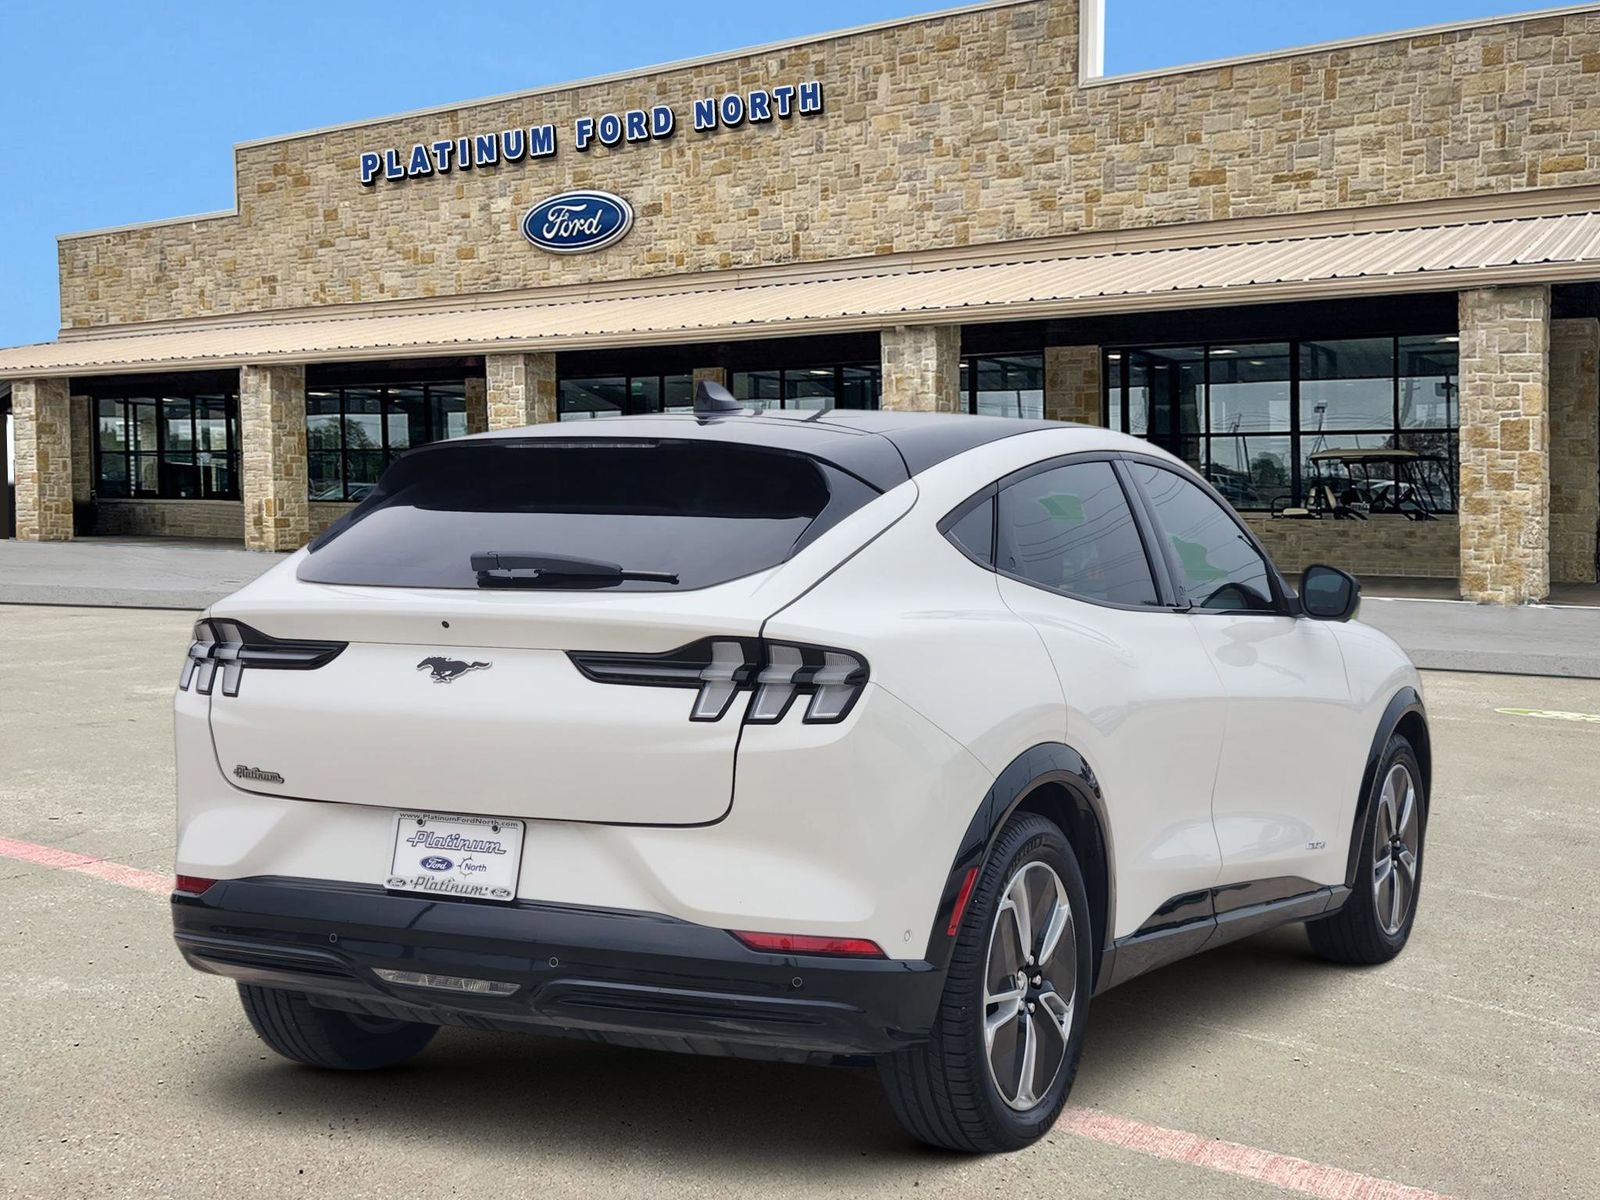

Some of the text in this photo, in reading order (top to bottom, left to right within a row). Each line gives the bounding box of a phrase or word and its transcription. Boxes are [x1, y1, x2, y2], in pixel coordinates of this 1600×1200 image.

[360, 82, 822, 185] PLATINUM FORD NORTH
[541, 204, 602, 239] Ford
[400, 813, 518, 828] www.PlatinumFordNorth.com
[407, 831, 507, 854] Platinum
[425, 858, 487, 872] Ford North
[413, 875, 488, 897] Platinum
